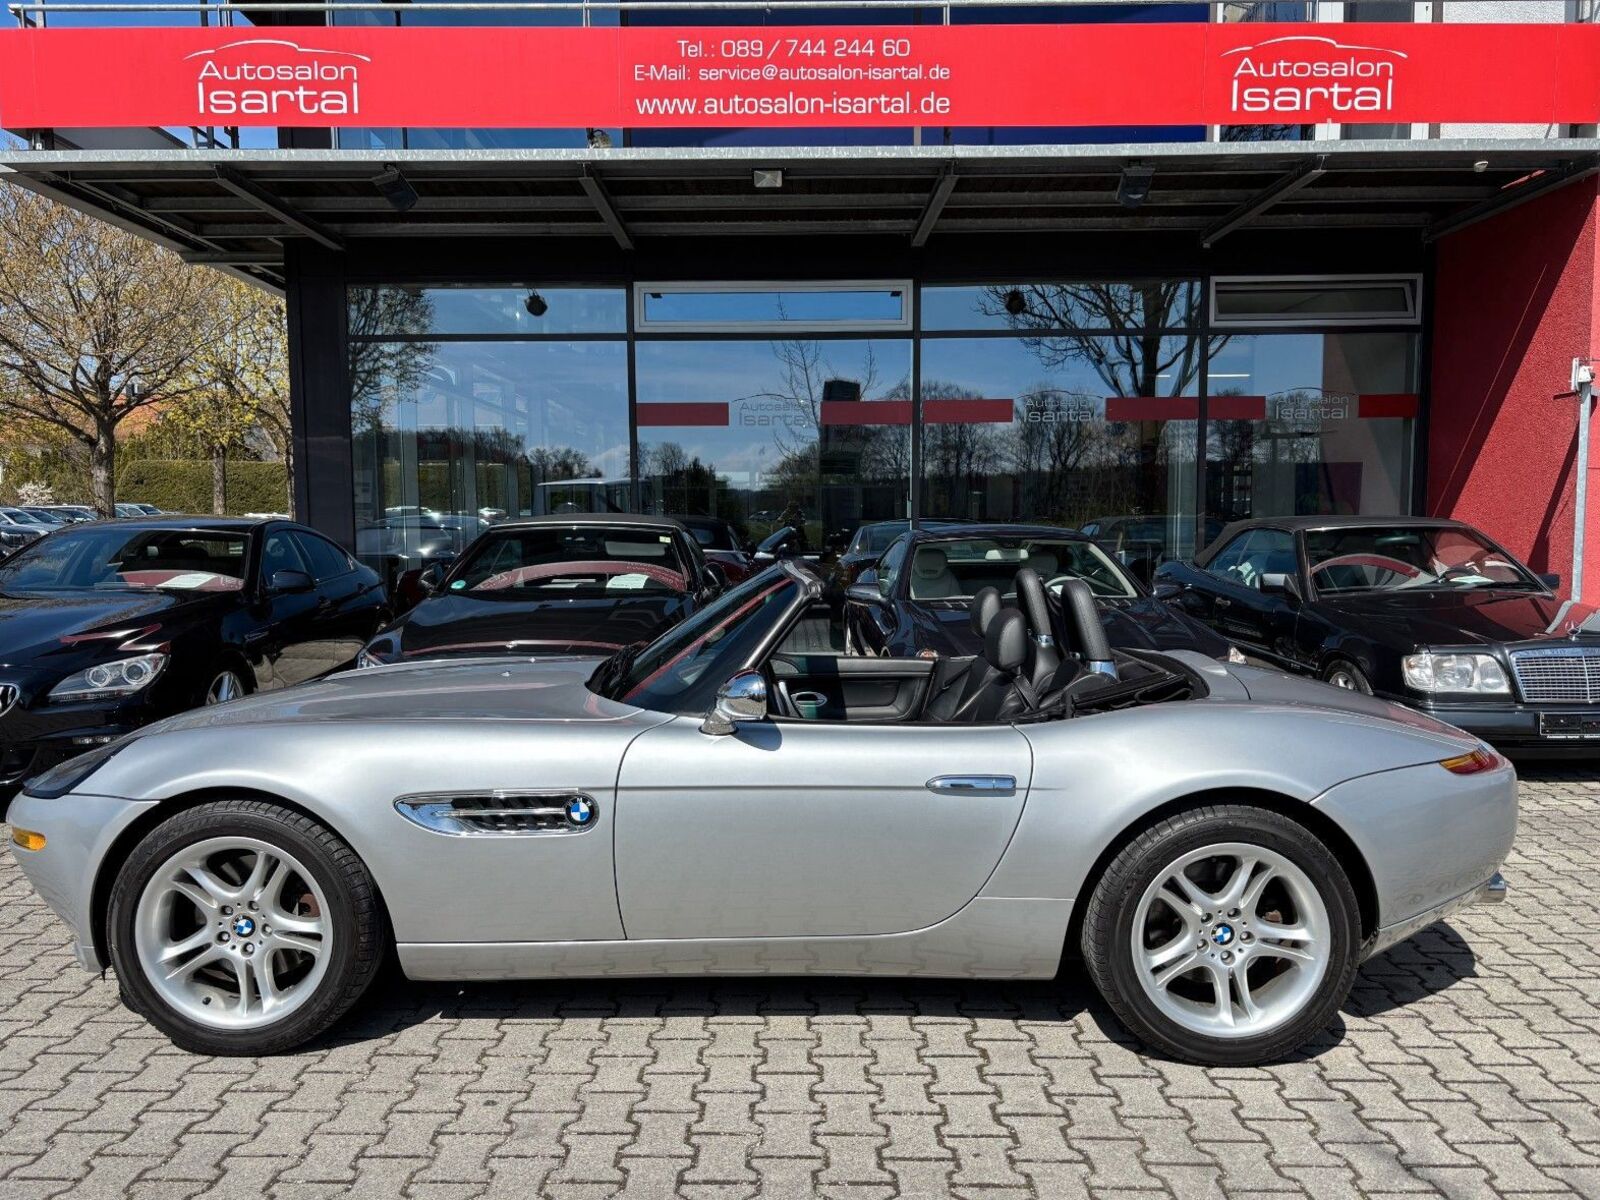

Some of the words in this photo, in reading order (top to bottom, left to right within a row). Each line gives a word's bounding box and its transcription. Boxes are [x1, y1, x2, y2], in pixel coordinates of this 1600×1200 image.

[677, 40, 715, 58] Tel.:
[721, 39, 763, 57] 089
[766, 39, 781, 60] /
[785, 39, 827, 57] 744
[834, 39, 875, 57] 244
[882, 39, 910, 57] 60
[198, 60, 358, 81] Autosalon
[634, 64, 691, 81] E-Mail:
[698, 63, 950, 81] service@autosalon-isartal.de
[1233, 56, 1393, 78] Autosalon
[198, 82, 359, 114] Isartal
[635, 90, 950, 115] www.autosalon-isartal.de
[1231, 78, 1393, 111] Isartal
[740, 402, 804, 412] Autosalo
[1025, 398, 1089, 408] Autosalo
[1275, 404, 1350, 419] Isartal
[739, 412, 805, 426] Isarta
[1023, 408, 1092, 422] Isarta
